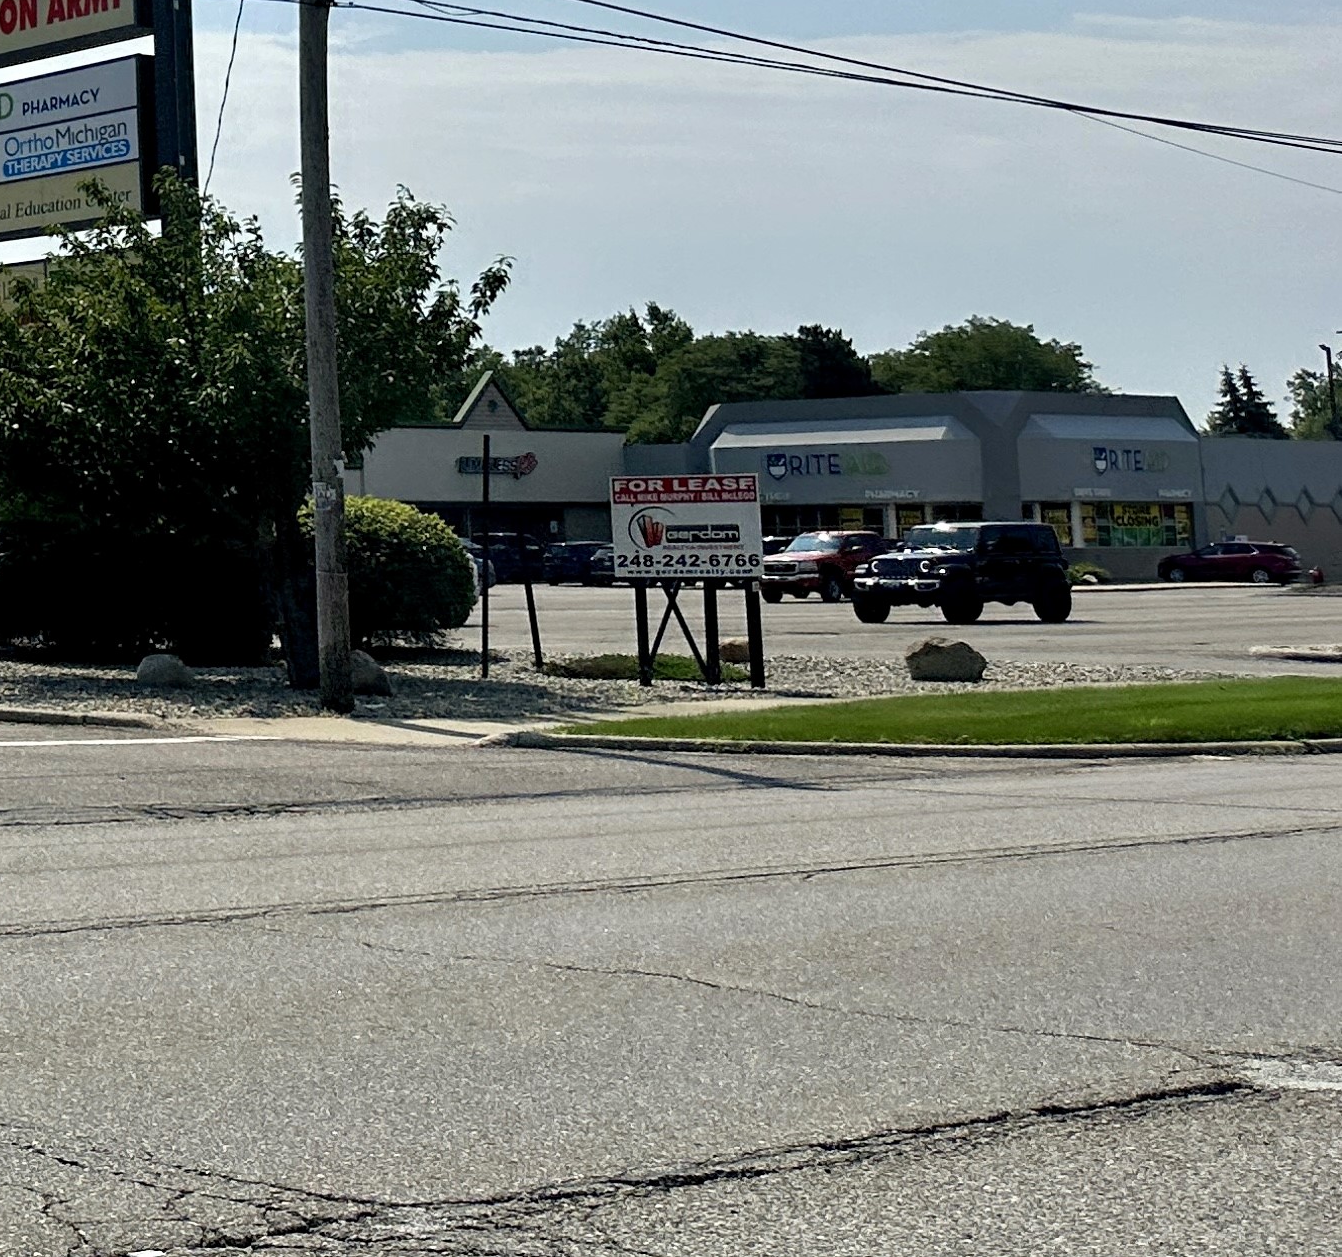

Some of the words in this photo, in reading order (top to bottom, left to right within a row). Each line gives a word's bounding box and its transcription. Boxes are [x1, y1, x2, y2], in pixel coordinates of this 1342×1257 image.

[21, 87, 101, 117] PHARMACY
[5, 150, 64, 175] THERAPY
[66, 141, 128, 164] SERVICES
[15, 195, 82, 219] Education
[85, 187, 133, 208] Cter
[789, 453, 841, 476] RITE
[1109, 449, 1144, 471] RITE
[614, 479, 665, 492] FOR
[615, 493, 636, 502] CALL
[637, 492, 658, 502] MIKE
[660, 492, 695, 501] MURPHY
[701, 491, 720, 500] BILL
[1116, 516, 1159, 528] CLOSING
[617, 553, 761, 568] 248-242-6766
